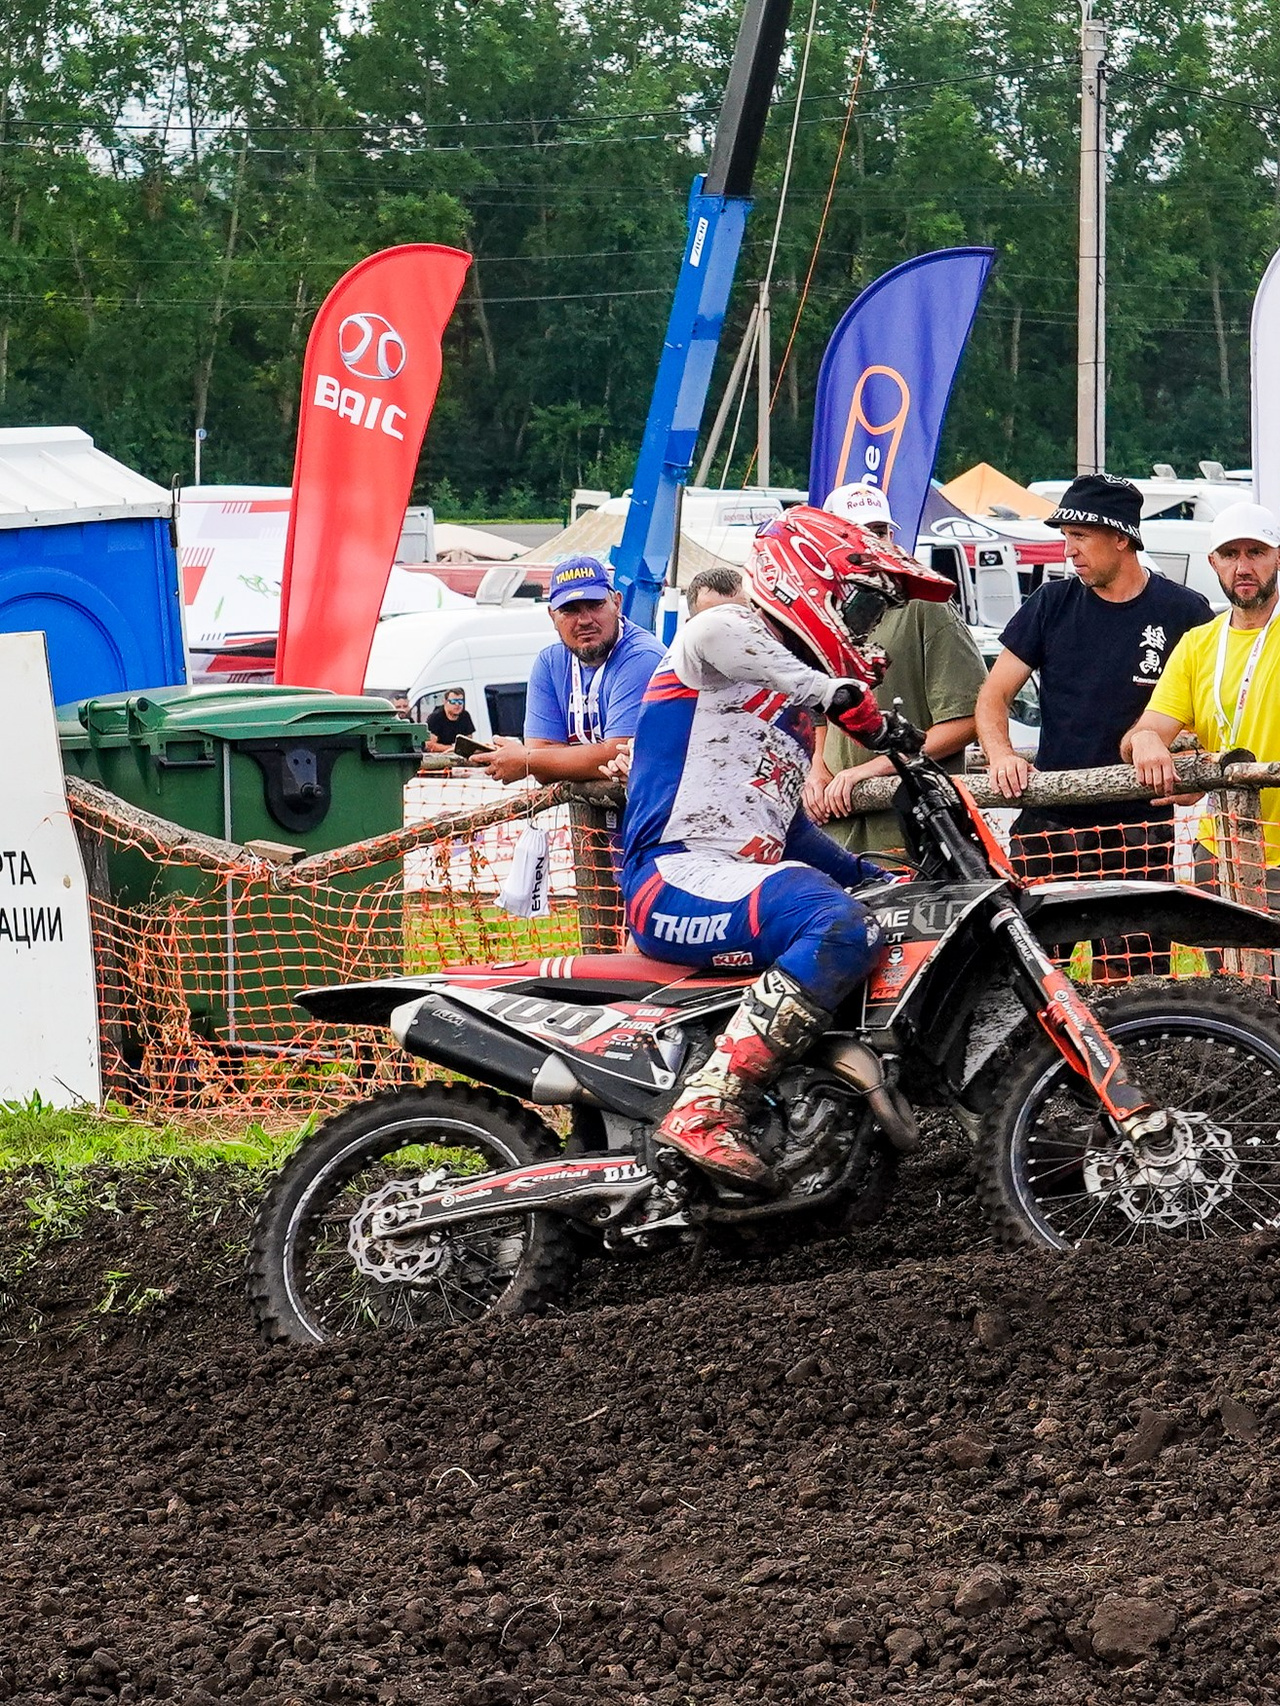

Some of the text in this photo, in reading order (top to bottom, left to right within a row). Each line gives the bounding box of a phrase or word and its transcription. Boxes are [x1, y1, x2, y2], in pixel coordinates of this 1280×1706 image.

[313, 374, 407, 441] BAIC
[847, 498, 882, 509] Red Bull
[556, 567, 596, 585] YAMAHA
[651, 911, 732, 945] THOR
[712, 951, 753, 967] KTM
[431, 1008, 467, 1026] KTM
[487, 994, 605, 1037] 100
[616, 1020, 656, 1032] THOR
[455, 1188, 493, 1203] brembo
